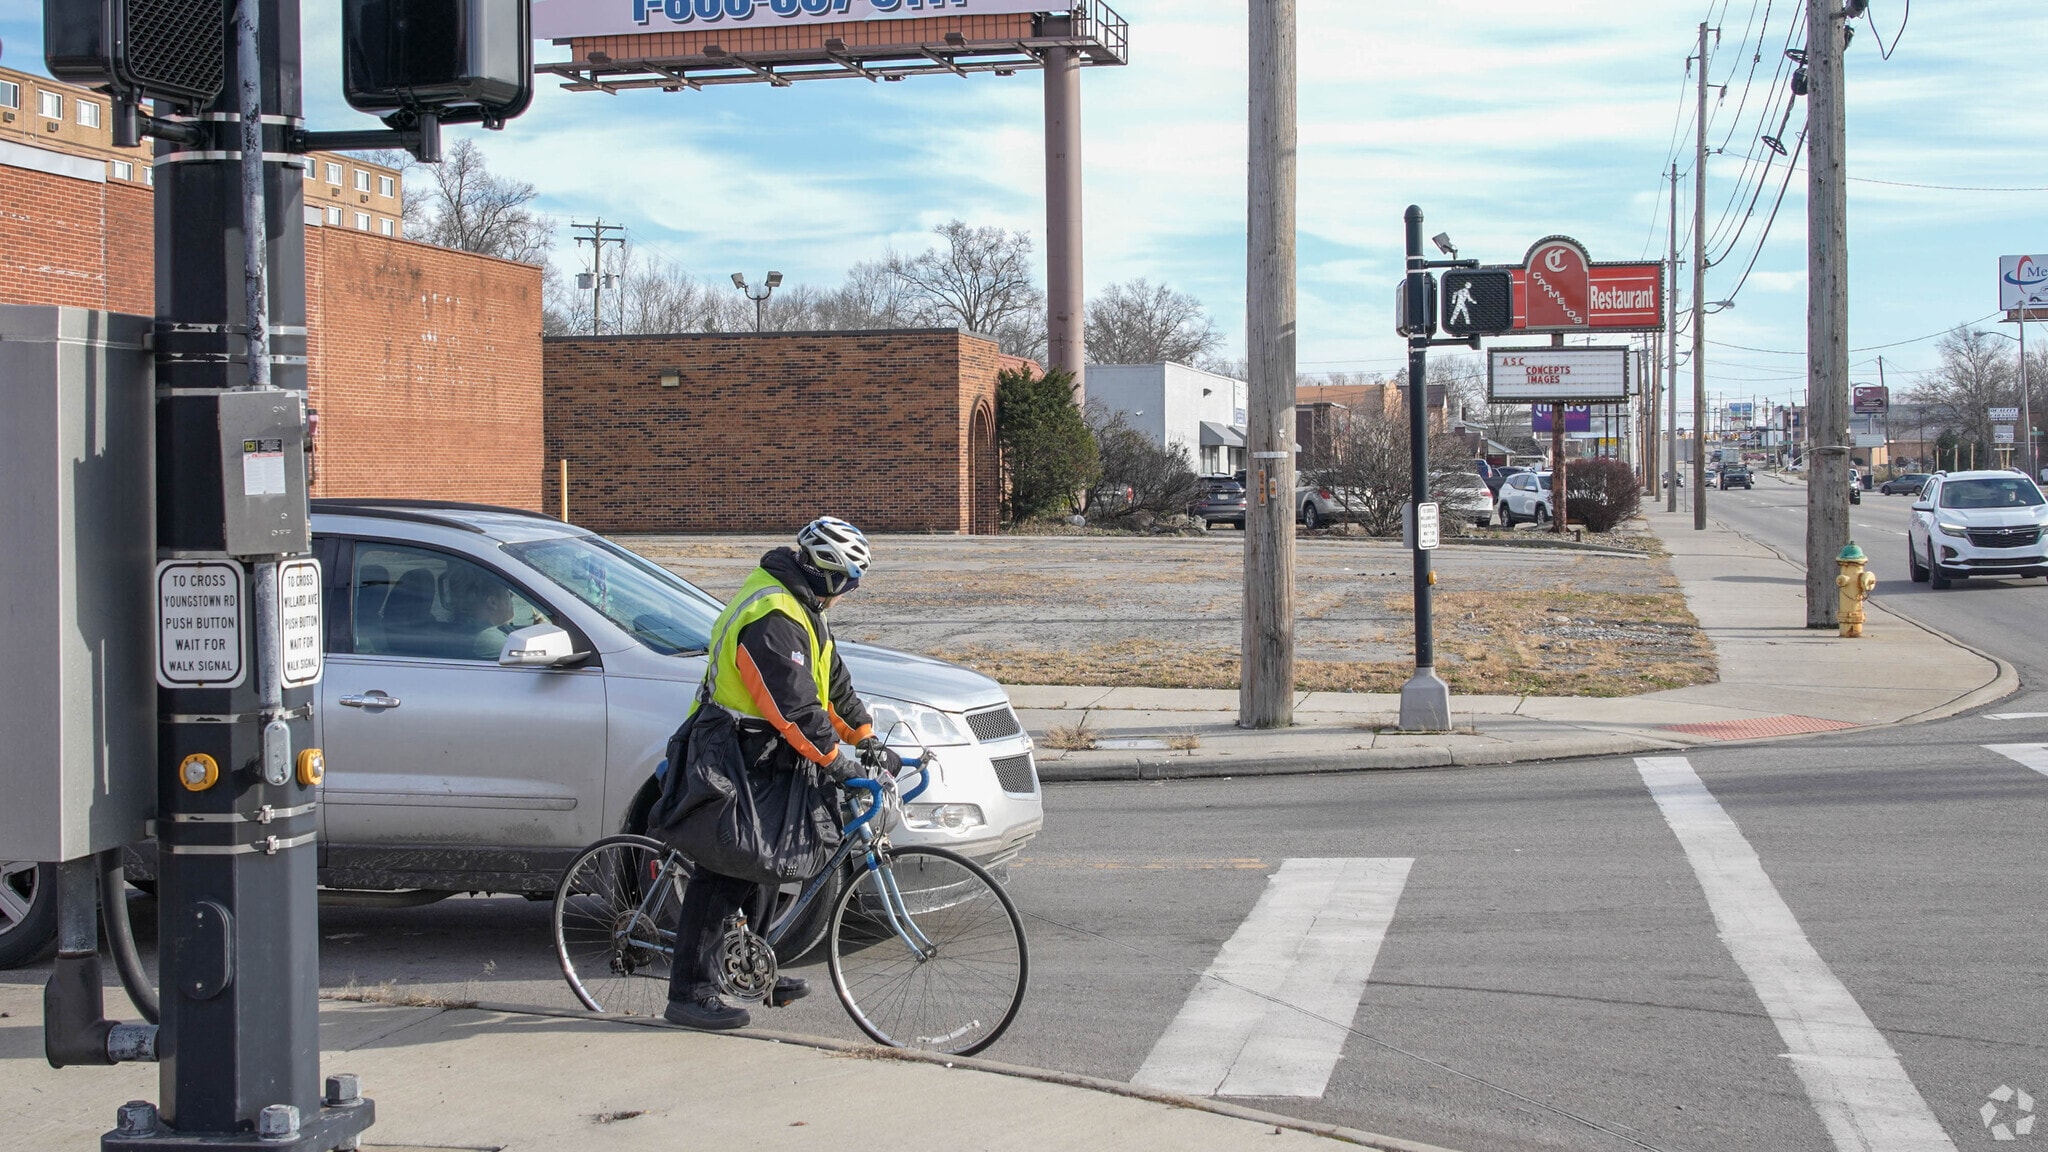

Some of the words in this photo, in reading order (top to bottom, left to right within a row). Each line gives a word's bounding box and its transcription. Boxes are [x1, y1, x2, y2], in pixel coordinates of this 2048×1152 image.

[1590, 285, 1654, 310] Restaurant
[1525, 366, 1571, 375] CONCEPTS
[1527, 375, 1560, 384] IMAGES
[173, 575, 186, 587] TO
[190, 575, 226, 587] CROSS
[287, 576, 295, 587] TO
[296, 574, 314, 587] CROSS
[164, 595, 221, 607] YOUNGSTOWN
[224, 595, 235, 607] RD
[284, 595, 306, 608] WILLARD
[307, 593, 318, 605] AVE
[165, 617, 193, 629] PUSH
[196, 617, 235, 629] BUTTON
[285, 618, 298, 630] PUSH
[299, 615, 317, 629] BUTTON
[175, 639, 200, 650] WAIT
[204, 638, 226, 650] FOR
[290, 638, 302, 650] WAIT
[303, 636, 314, 649] FOR
[169, 660, 195, 671] WALK
[198, 660, 233, 671] SIGNAL
[287, 659, 300, 671] WALK
[300, 657, 317, 668] SIGNAL
